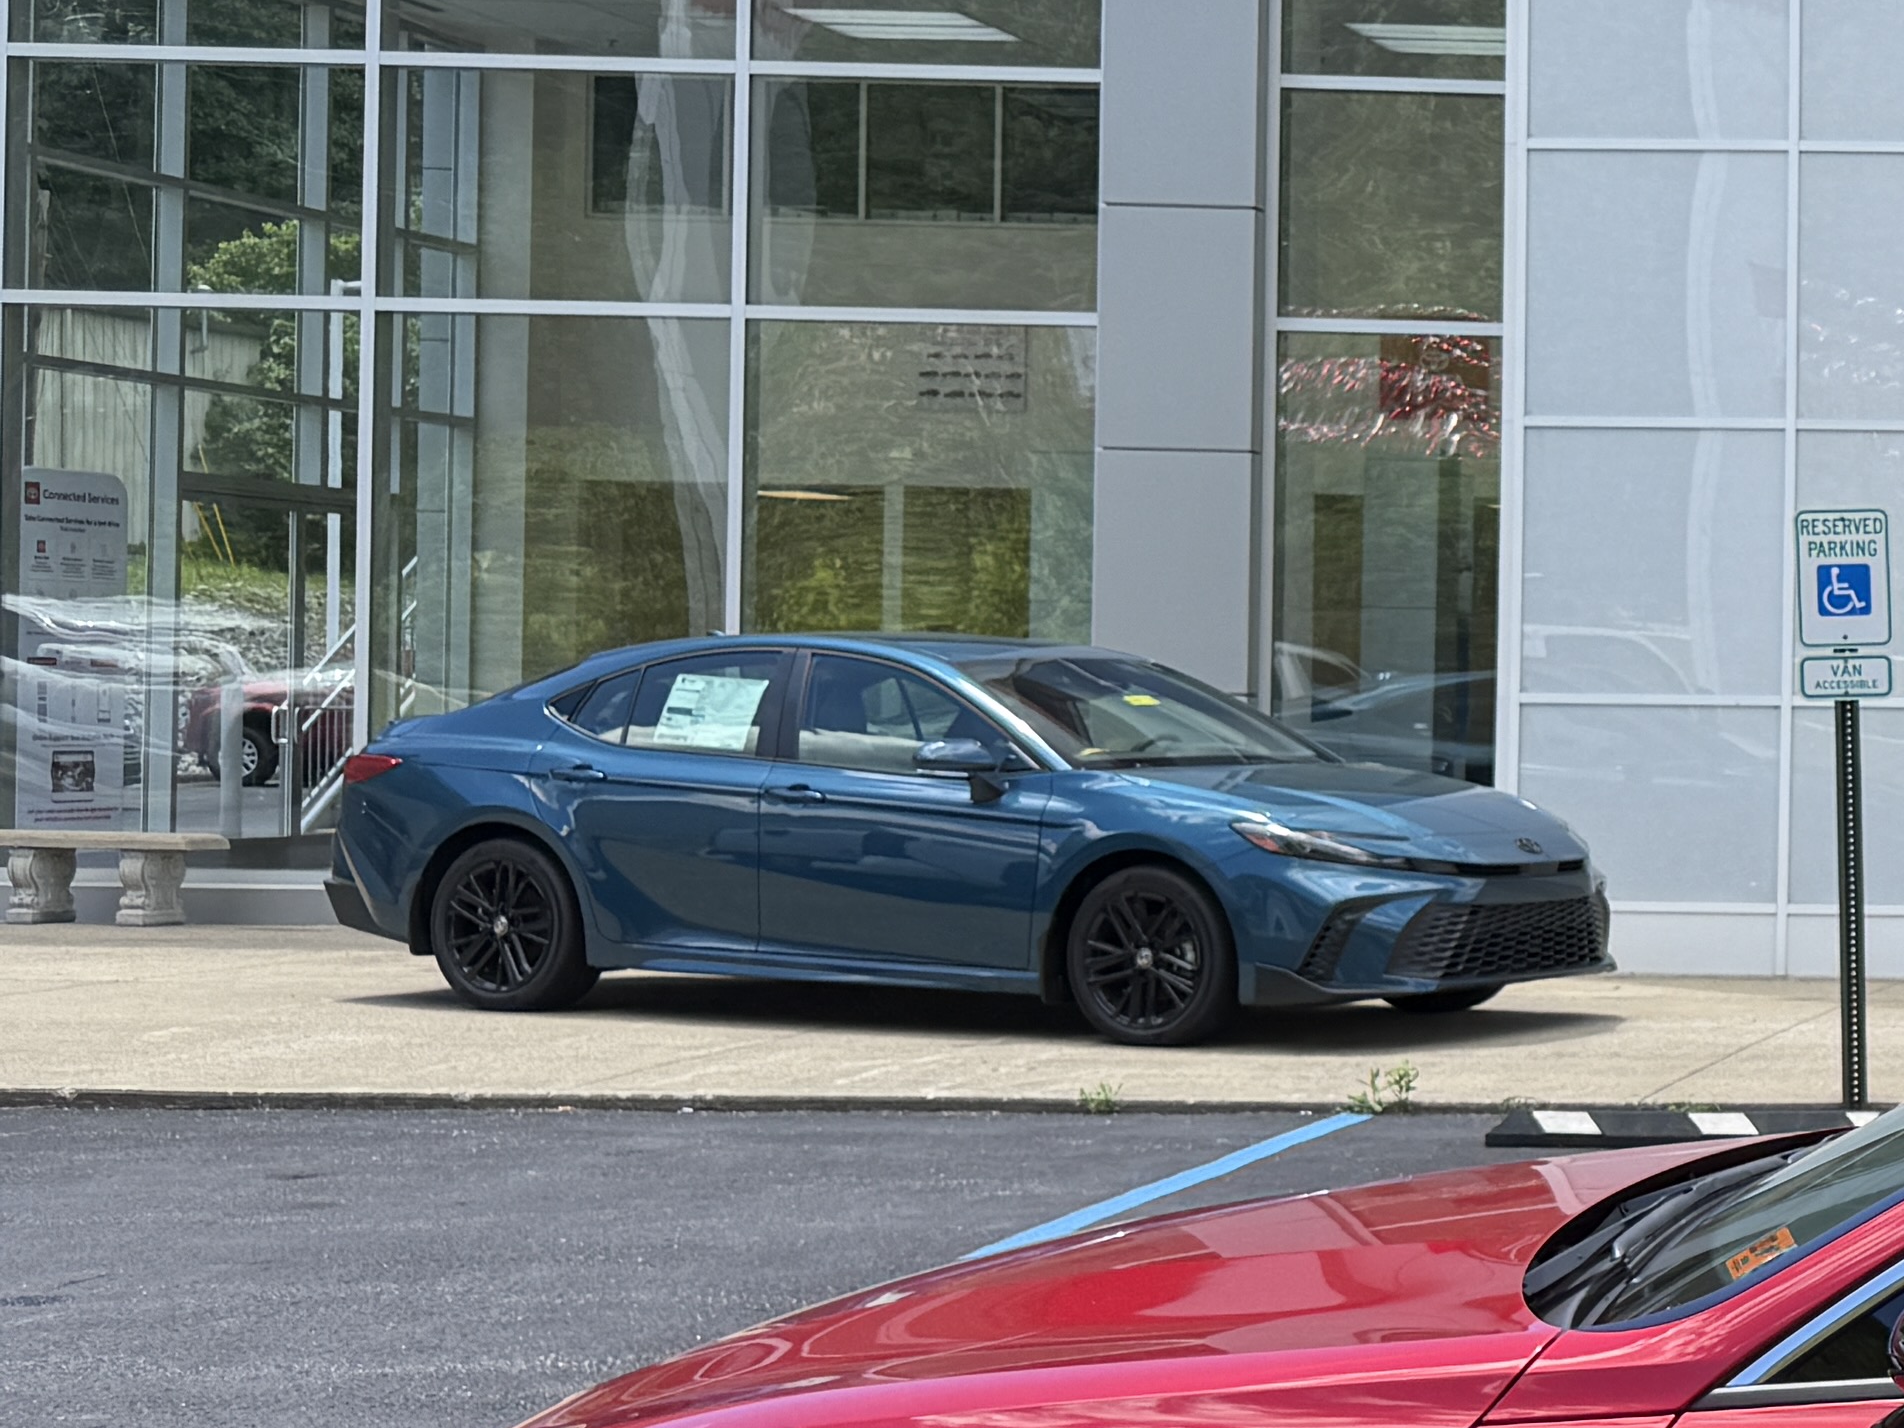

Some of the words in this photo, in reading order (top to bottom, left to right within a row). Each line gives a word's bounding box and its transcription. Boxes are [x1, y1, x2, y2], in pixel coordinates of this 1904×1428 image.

[42, 489, 86, 503] Connected
[87, 492, 120, 506] Services
[1801, 517, 1883, 536] RESERVED
[1808, 540, 1878, 558] PARKING
[1831, 664, 1862, 677] VAN
[1815, 679, 1879, 690] ACCESSIBLE
